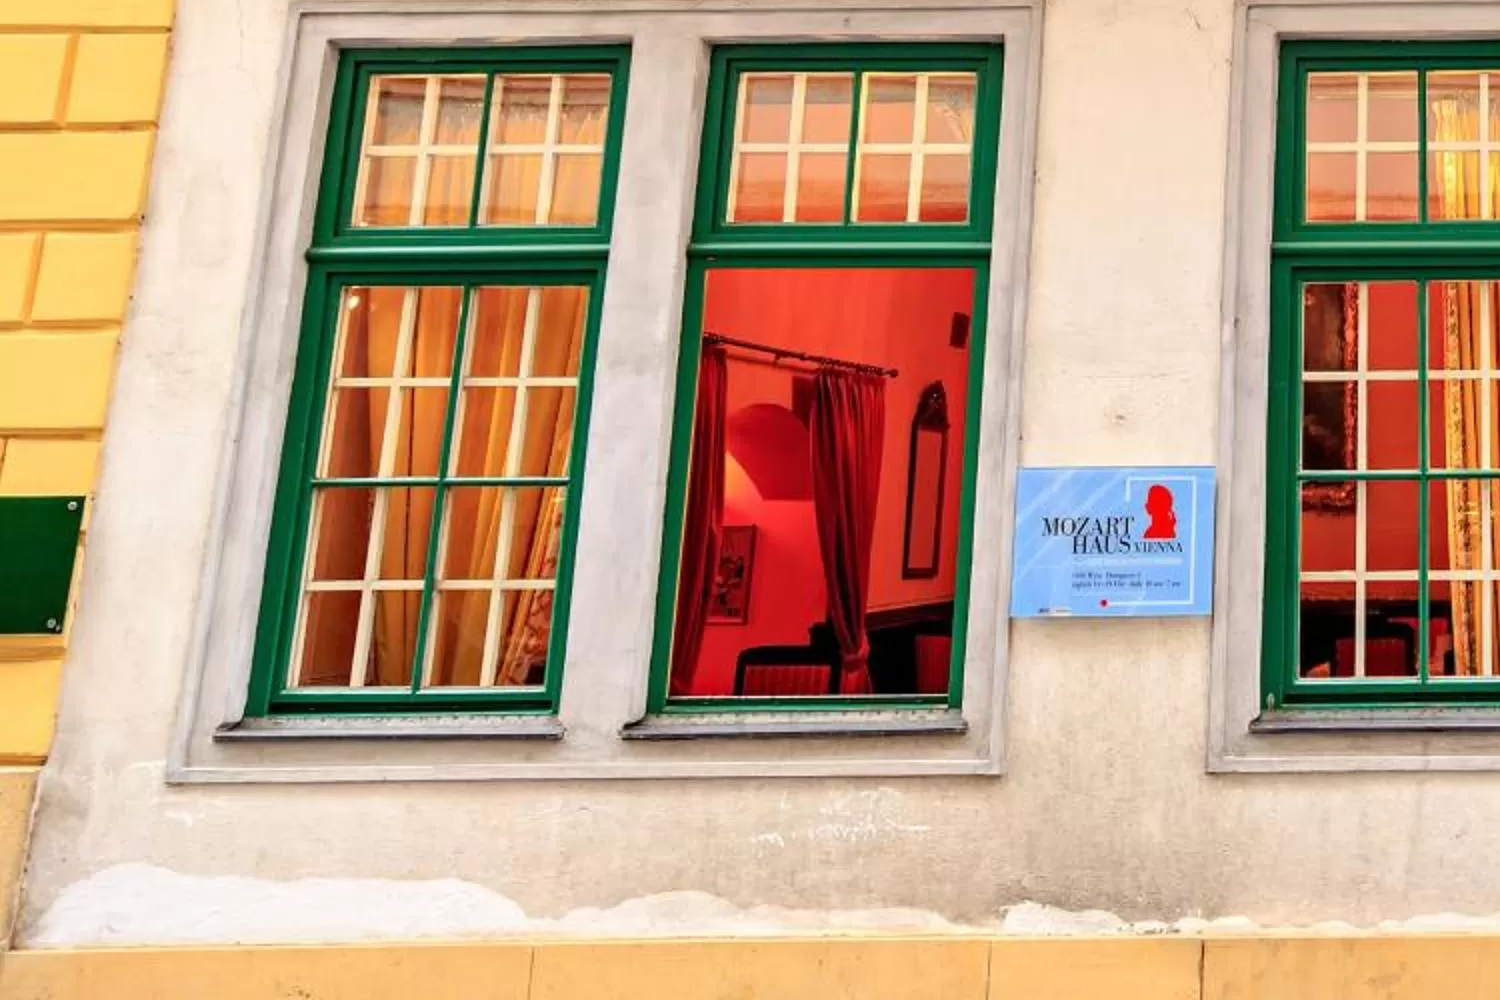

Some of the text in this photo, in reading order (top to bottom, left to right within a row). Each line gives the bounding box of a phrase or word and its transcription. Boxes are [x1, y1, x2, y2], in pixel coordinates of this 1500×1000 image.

[1041, 516, 1135, 537] MOZART
[1072, 535, 1184, 555] HAUS VIENNA
